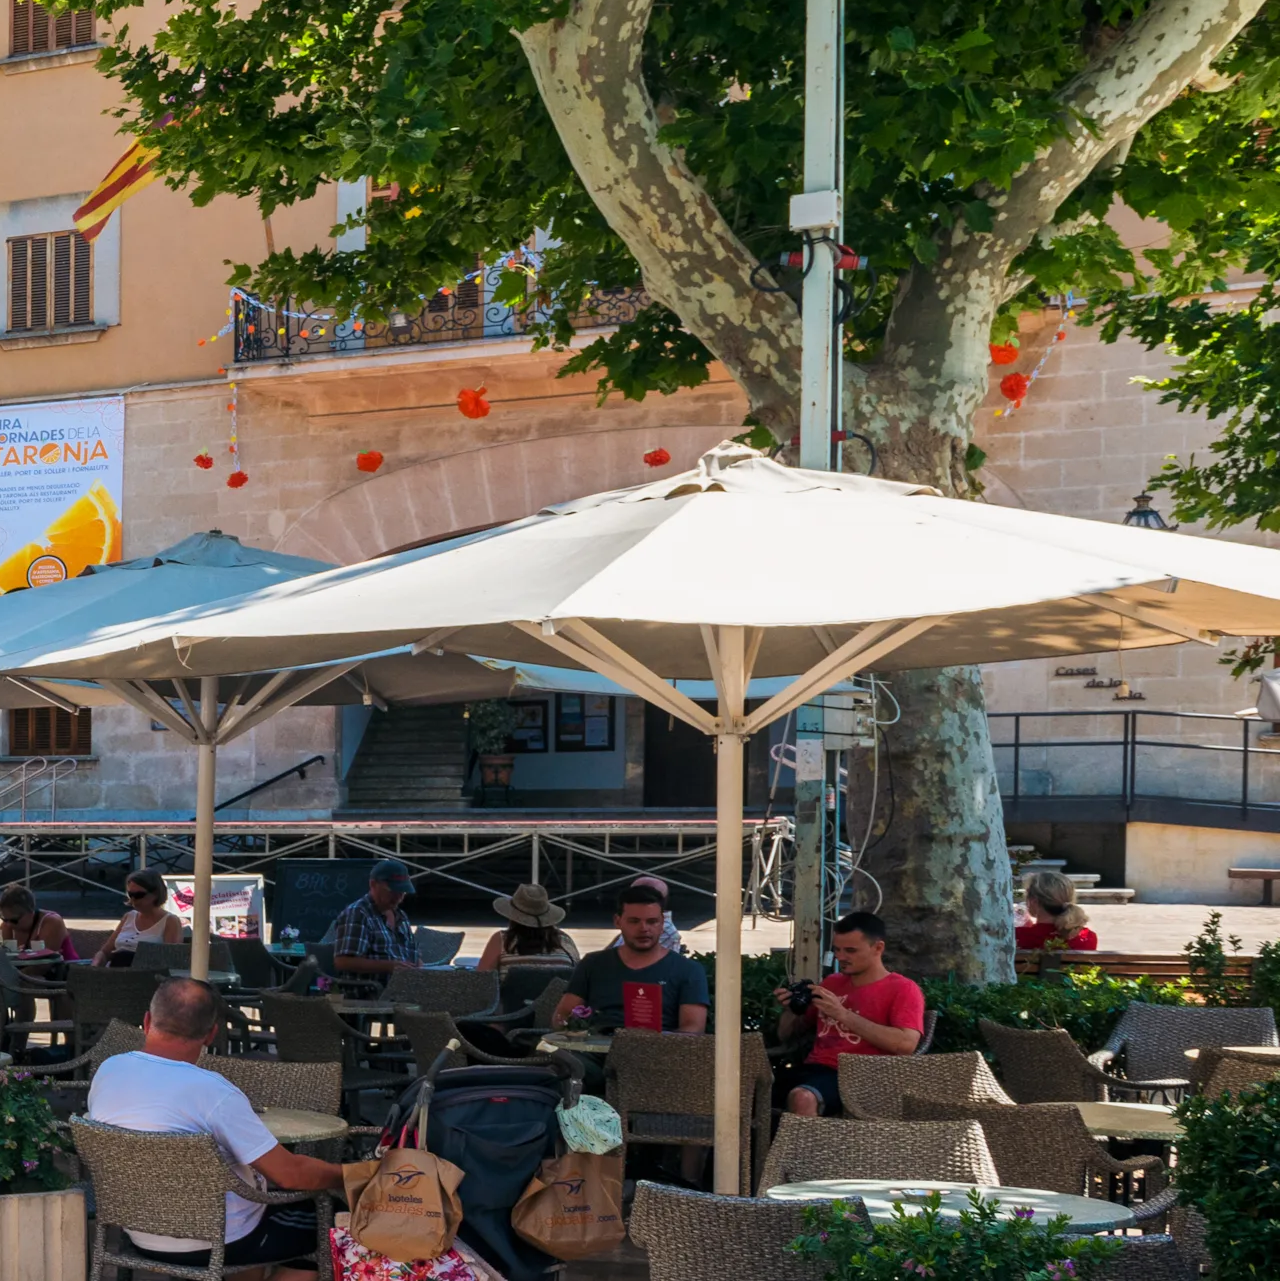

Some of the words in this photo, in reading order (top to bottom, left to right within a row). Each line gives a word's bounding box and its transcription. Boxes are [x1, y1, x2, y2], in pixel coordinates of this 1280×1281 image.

[68, 427, 85, 440] DE
[87, 426, 101, 438] LA
[1055, 666, 1097, 676] Cases
[1085, 678, 1105, 687] de
[1114, 690, 1144, 700] la
[295, 872, 330, 890] BAR
[388, 1193, 423, 1204] hoteles
